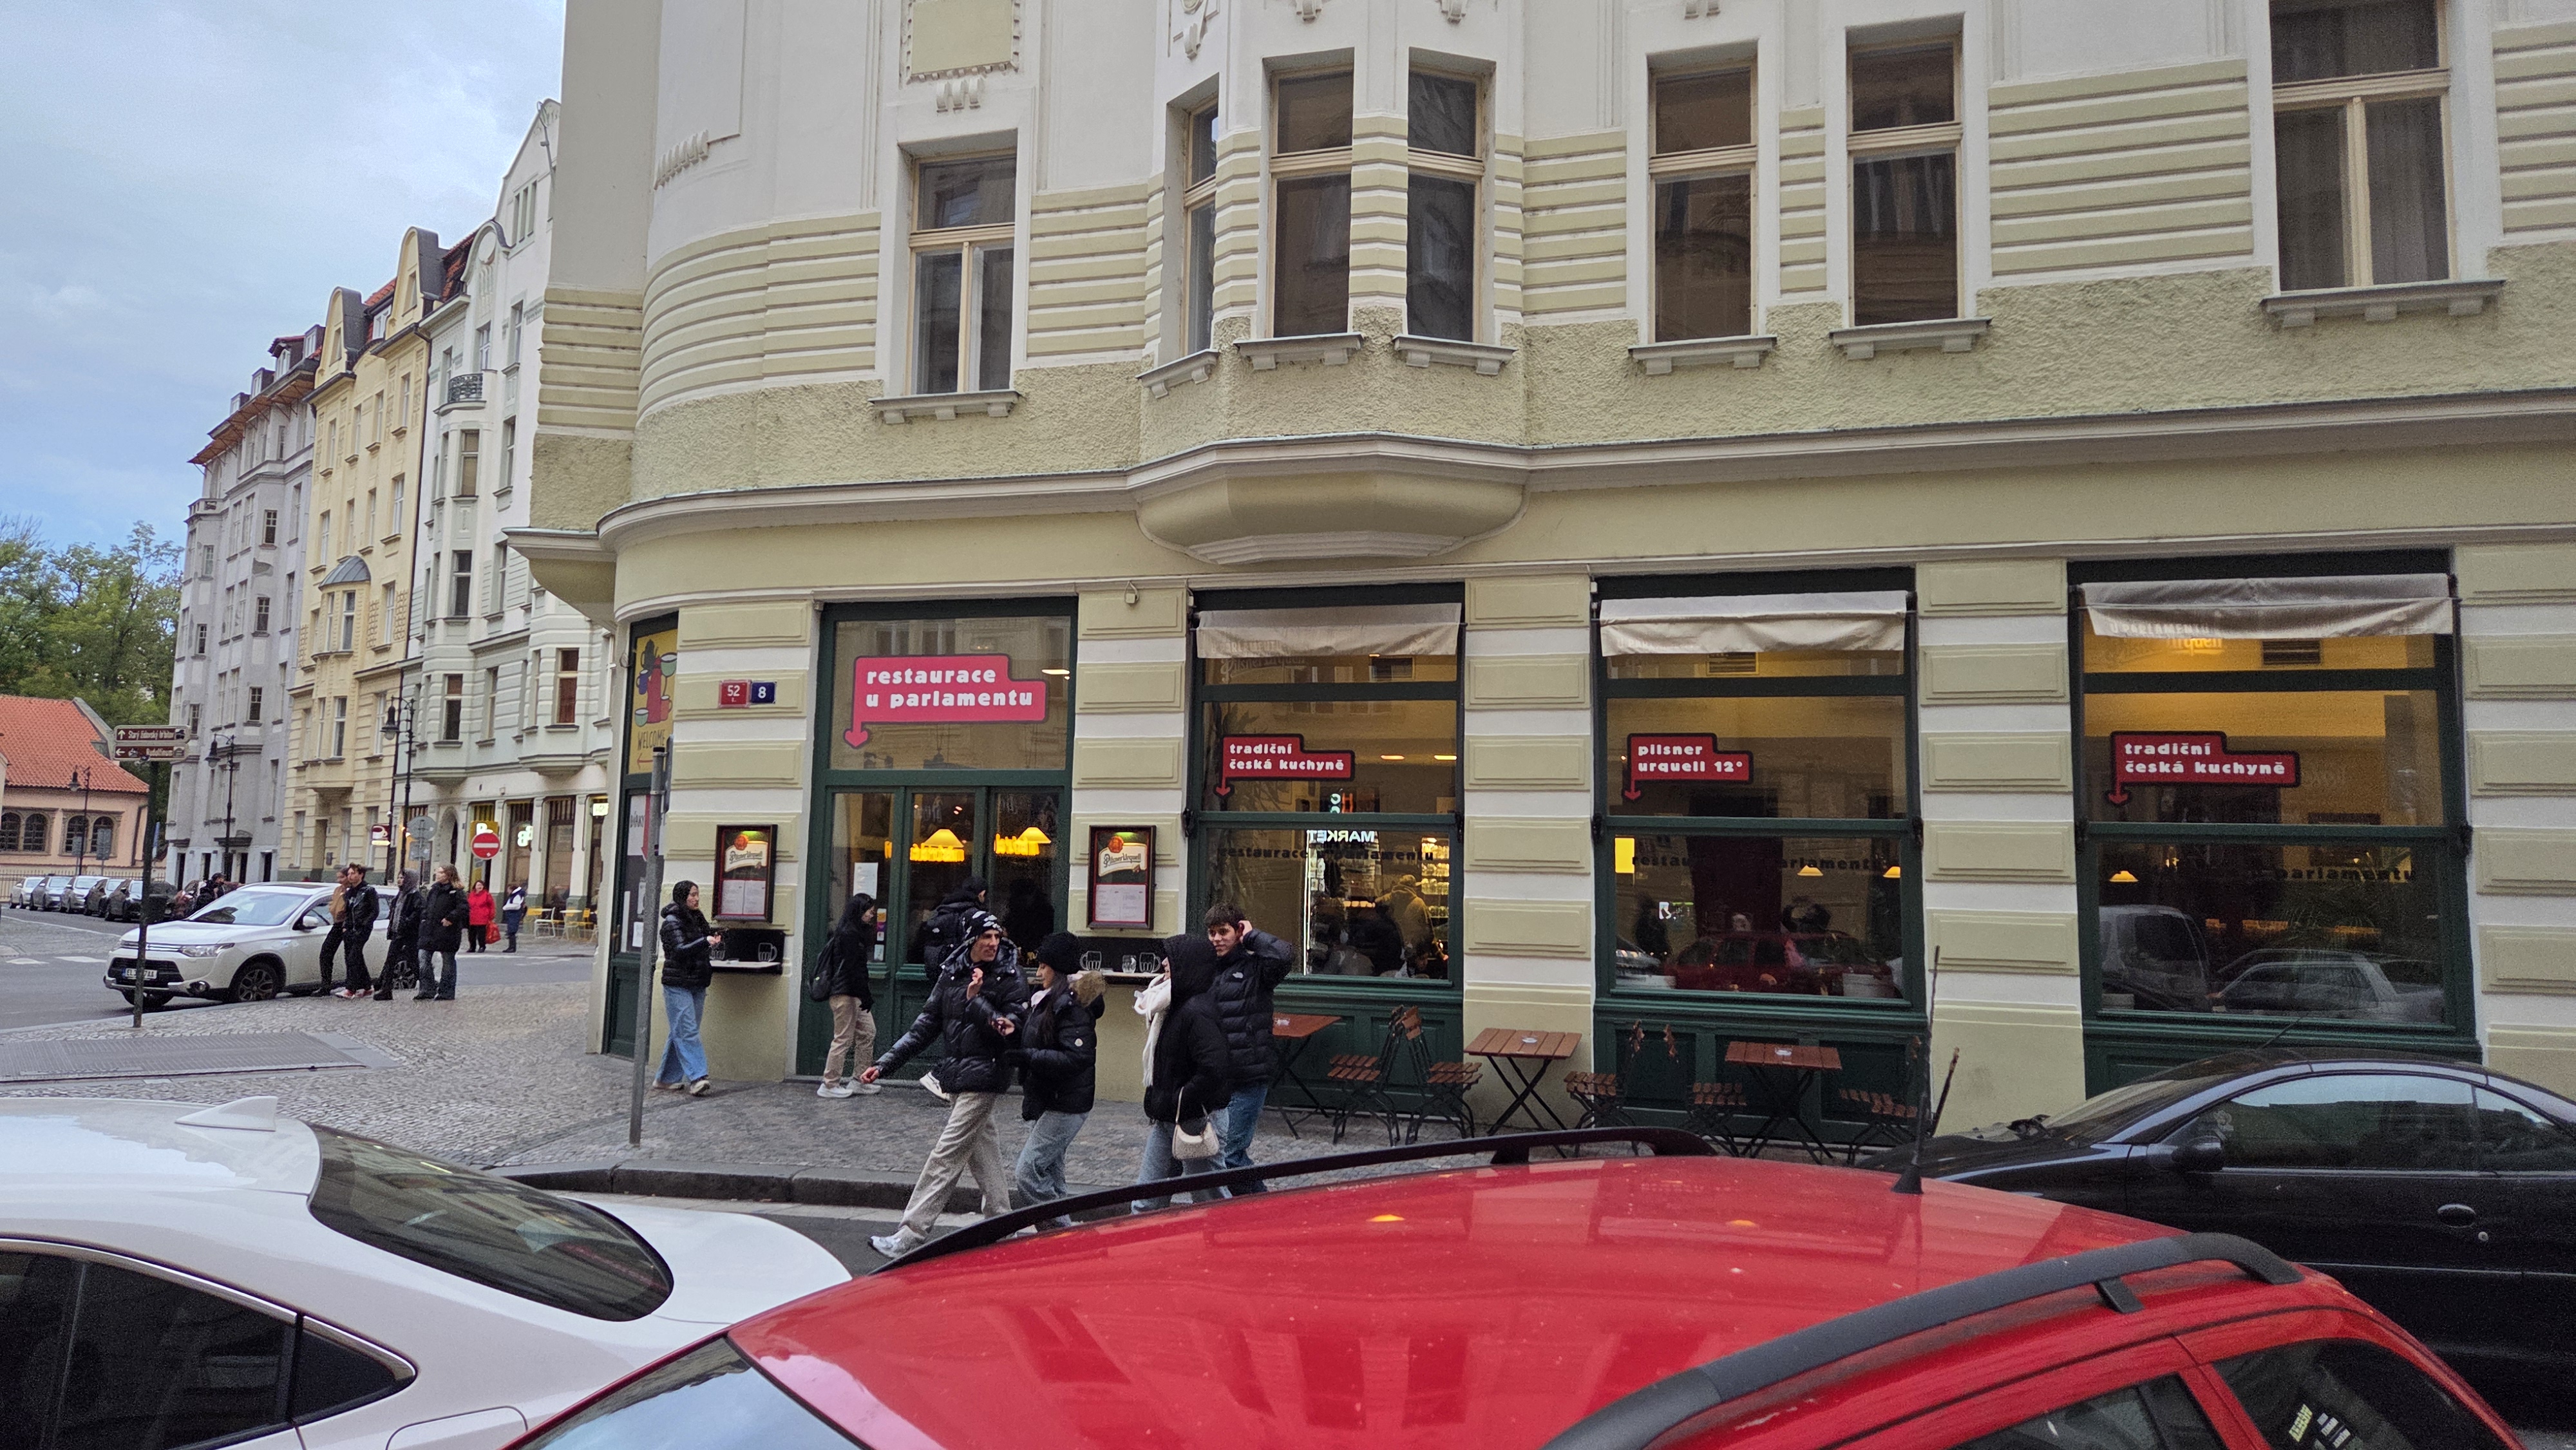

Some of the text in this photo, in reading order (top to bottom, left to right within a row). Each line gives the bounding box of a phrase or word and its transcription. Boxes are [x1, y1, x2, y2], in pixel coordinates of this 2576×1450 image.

[867, 668, 996, 684] restaurace
[727, 684, 741, 697] 52
[757, 686, 766, 699] 8
[866, 690, 1032, 709] u parlamentu
[1229, 743, 1293, 755] tradiční
[1638, 744, 1703, 757] pilsner
[2124, 742, 2211, 755] tradiční
[1229, 758, 1344, 771] česká kuchyně
[1638, 760, 1743, 773] urquell 12°
[2125, 760, 2286, 776] česká kuchyně
